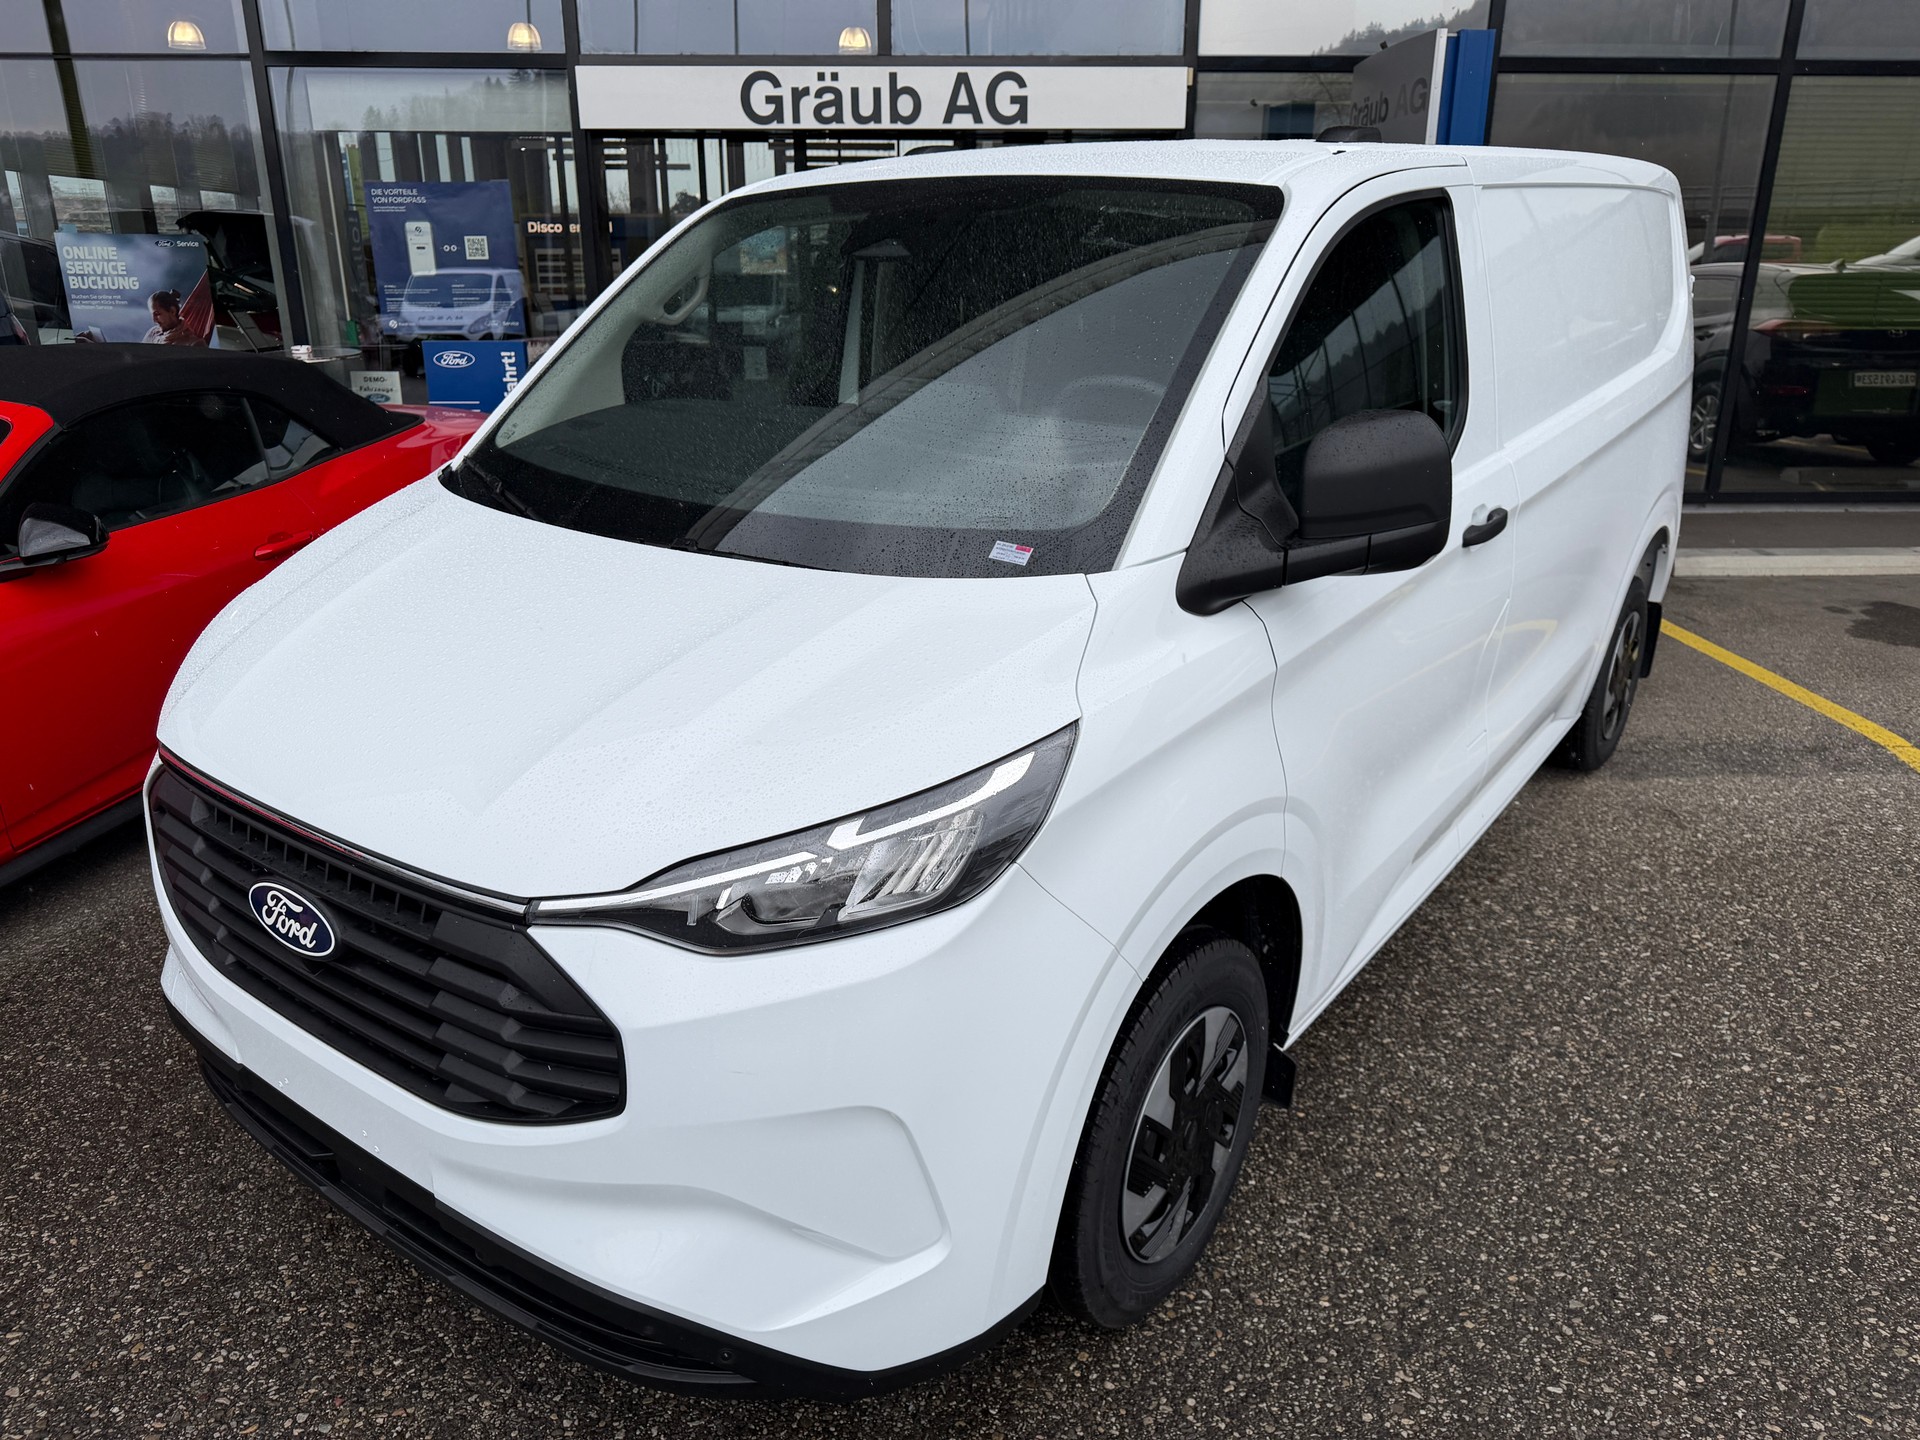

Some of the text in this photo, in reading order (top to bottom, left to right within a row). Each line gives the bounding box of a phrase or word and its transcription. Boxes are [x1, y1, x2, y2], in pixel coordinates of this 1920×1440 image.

[740, 70, 1029, 126] Gräub AG
[1394, 77, 1428, 118] AG
[371, 188, 418, 196] DIE VORTEILE
[372, 196, 427, 204] VON FORDPASS
[176, 240, 200, 248] Service
[62, 246, 118, 260] ONLINE
[65, 261, 127, 275] SERVICE
[68, 276, 140, 290] BUCHUNG
[261, 889, 318, 949] Ford
